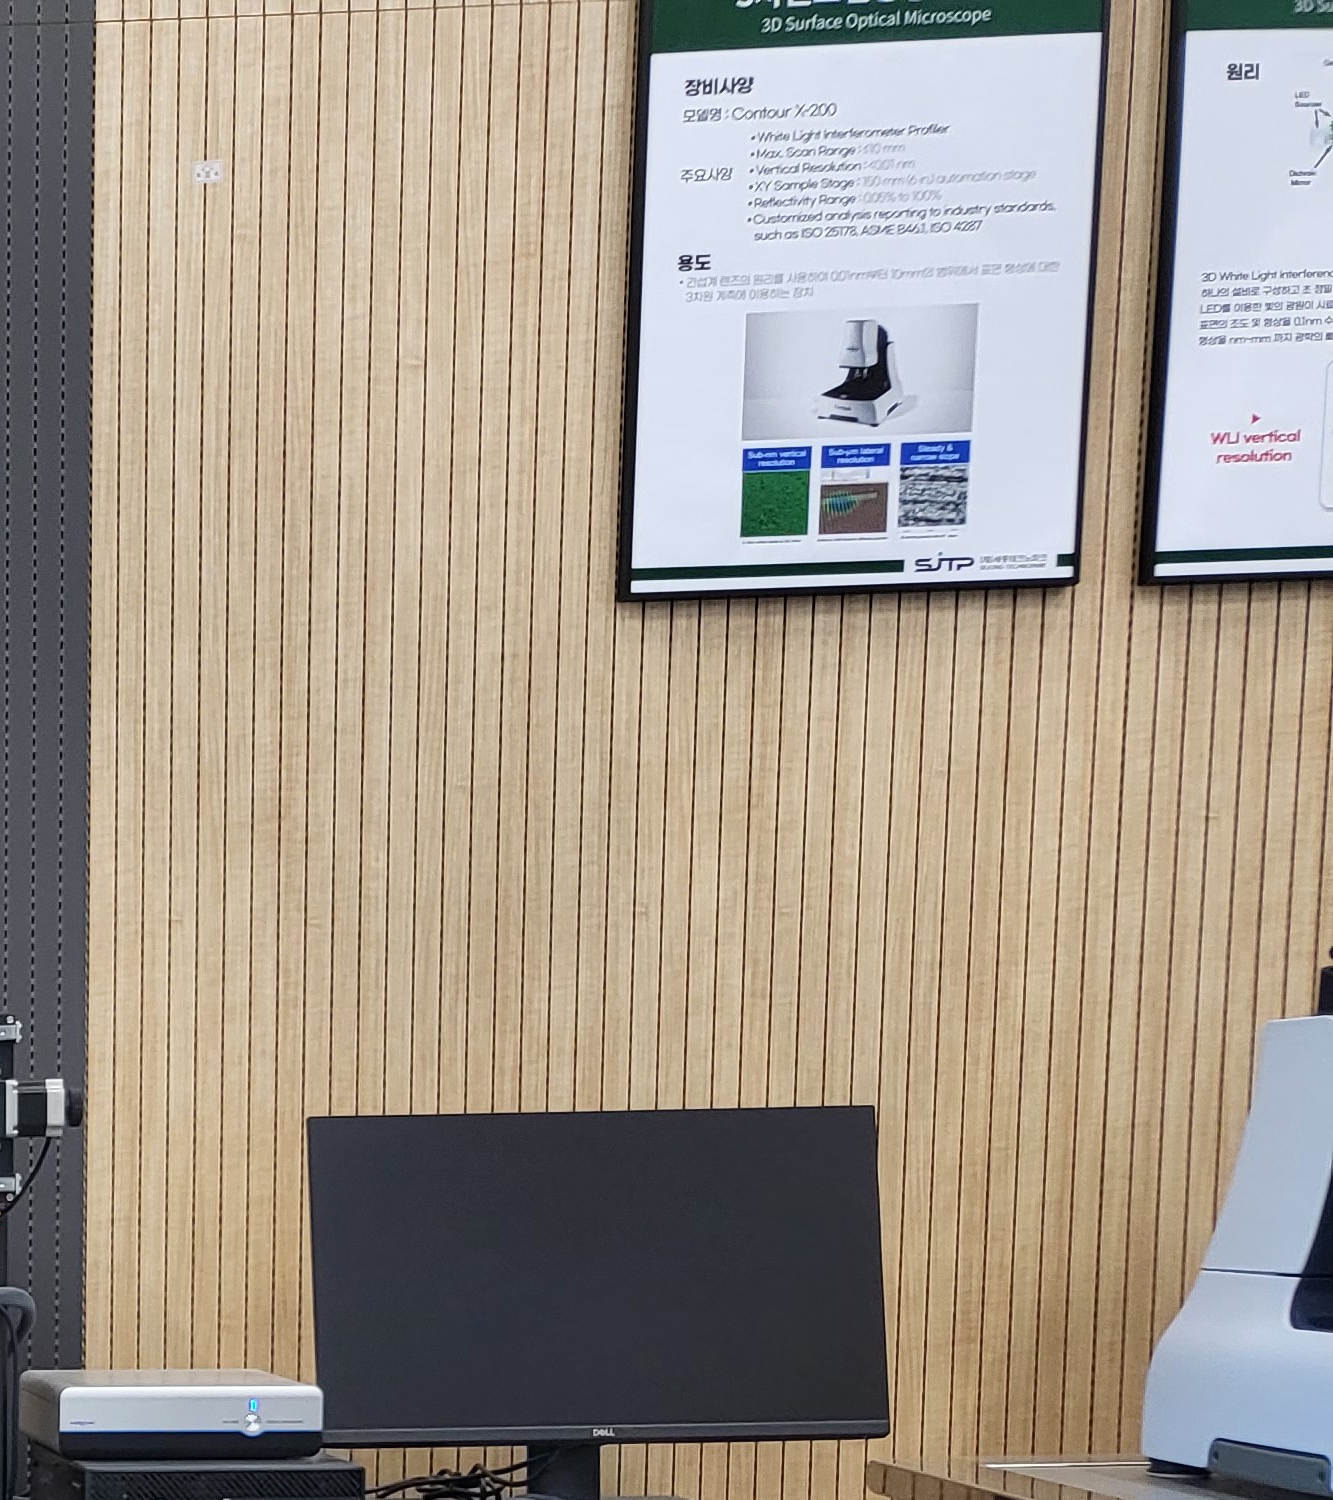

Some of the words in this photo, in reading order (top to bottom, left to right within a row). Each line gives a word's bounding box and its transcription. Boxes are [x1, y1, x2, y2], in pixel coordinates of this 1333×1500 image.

[761, 18, 782, 33] 3D
[785, 16, 842, 33] Surface
[846, 11, 901, 31] Optical
[904, 9, 991, 26] Microscope
[1227, 63, 1259, 80] 원리
[685, 76, 754, 96] 장비사양
[684, 107, 722, 123] 모델명
[732, 105, 792, 120] Contour
[793, 131, 821, 143] Light
[681, 168, 733, 182] 주요사양
[756, 163, 799, 175] Vertical
[753, 212, 822, 224] Customized
[930, 207, 941, 216] to
[754, 229, 782, 241] such
[784, 231, 799, 239] as
[802, 228, 822, 238] ISO
[678, 254, 711, 272] 용도
[1201, 273, 1216, 281] 3D
[1252, 271, 1277, 282] Light
[1243, 429, 1301, 443] vertical
[1216, 449, 1292, 464] resolution
